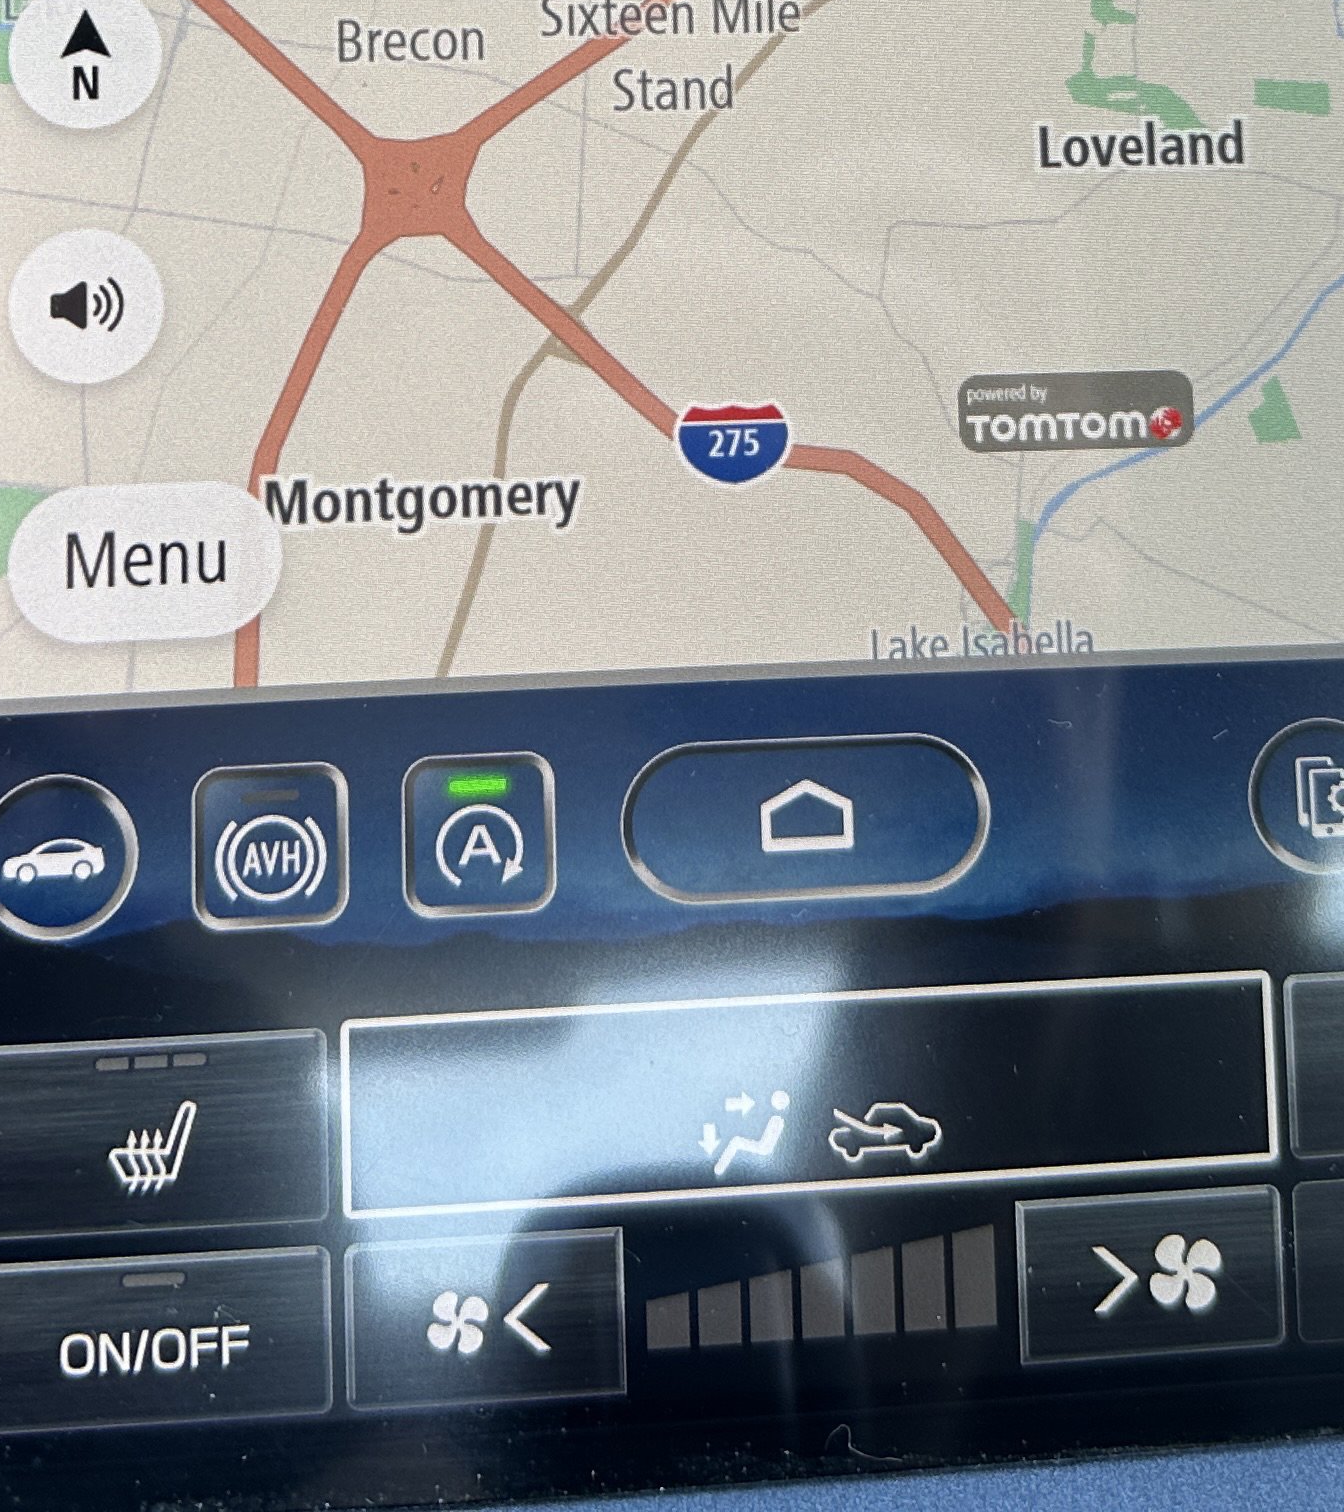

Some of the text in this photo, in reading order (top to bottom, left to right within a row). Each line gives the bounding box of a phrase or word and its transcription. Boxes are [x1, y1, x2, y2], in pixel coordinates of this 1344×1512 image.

[338, 20, 485, 63] Brecon
[73, 66, 99, 100] N
[613, 65, 735, 113] Stand
[1038, 120, 1246, 170] Loveland
[966, 384, 1048, 405] powered by
[709, 431, 760, 457] 275
[265, 479, 581, 533] Montgomery
[65, 531, 228, 589] Menu
[871, 619, 1095, 660] Lake Isabella
[242, 839, 302, 877] AVH
[59, 1324, 250, 1376] ON/OFF
